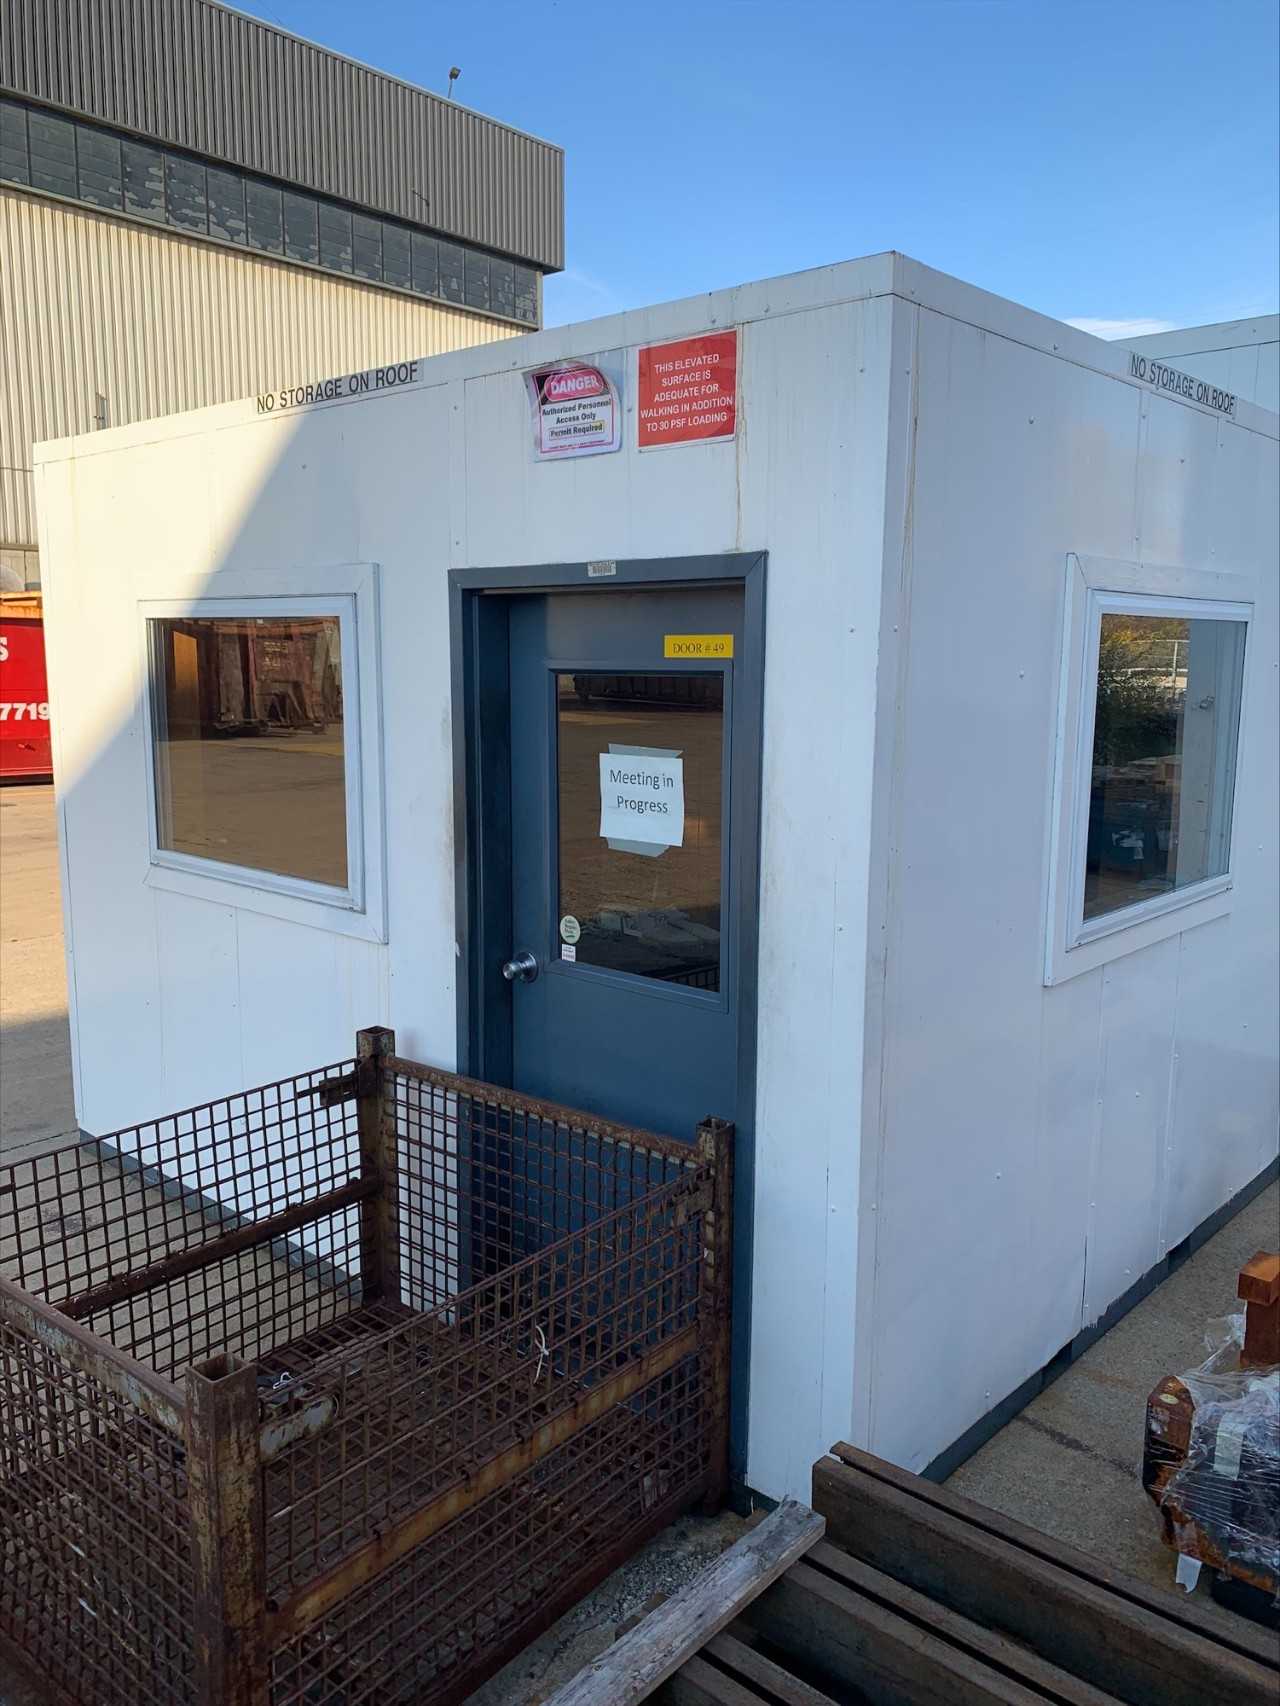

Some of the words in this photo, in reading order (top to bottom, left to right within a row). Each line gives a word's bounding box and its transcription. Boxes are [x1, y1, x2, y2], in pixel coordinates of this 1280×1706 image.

[655, 361, 673, 374] THIS
[675, 353, 719, 370] ELEVATED
[257, 394, 274, 412] NO
[280, 378, 343, 408] STORAGE
[349, 373, 369, 393] ON
[375, 361, 418, 387] ROOF
[550, 375, 600, 395] DANGER
[662, 371, 700, 387] SURFACE
[703, 370, 711, 380] IS
[1131, 353, 1146, 378] NO
[1149, 362, 1194, 397] STORAGE
[1197, 383, 1210, 403] ON
[1212, 389, 1235, 412] ROOF
[654, 386, 699, 402] ADEQUATE
[701, 383, 719, 395] FOR
[543, 404, 577, 416] Authorized
[640, 404, 679, 418] WALKING
[681, 403, 690, 413] IN
[692, 396, 733, 410] ADDITION
[556, 415, 580, 425] Access
[581, 411, 597, 421] Only
[646, 422, 658, 432] TO
[670, 418, 686, 429] PSF
[688, 411, 727, 427] LOADING
[550, 427, 572, 437] Permit
[573, 422, 603, 434] Required
[673, 643, 702, 654] DOOR
[713, 642, 724, 653] 49
[610, 769, 660, 790] Meeting
[662, 773, 674, 788] in
[617, 795, 668, 814] Progress
